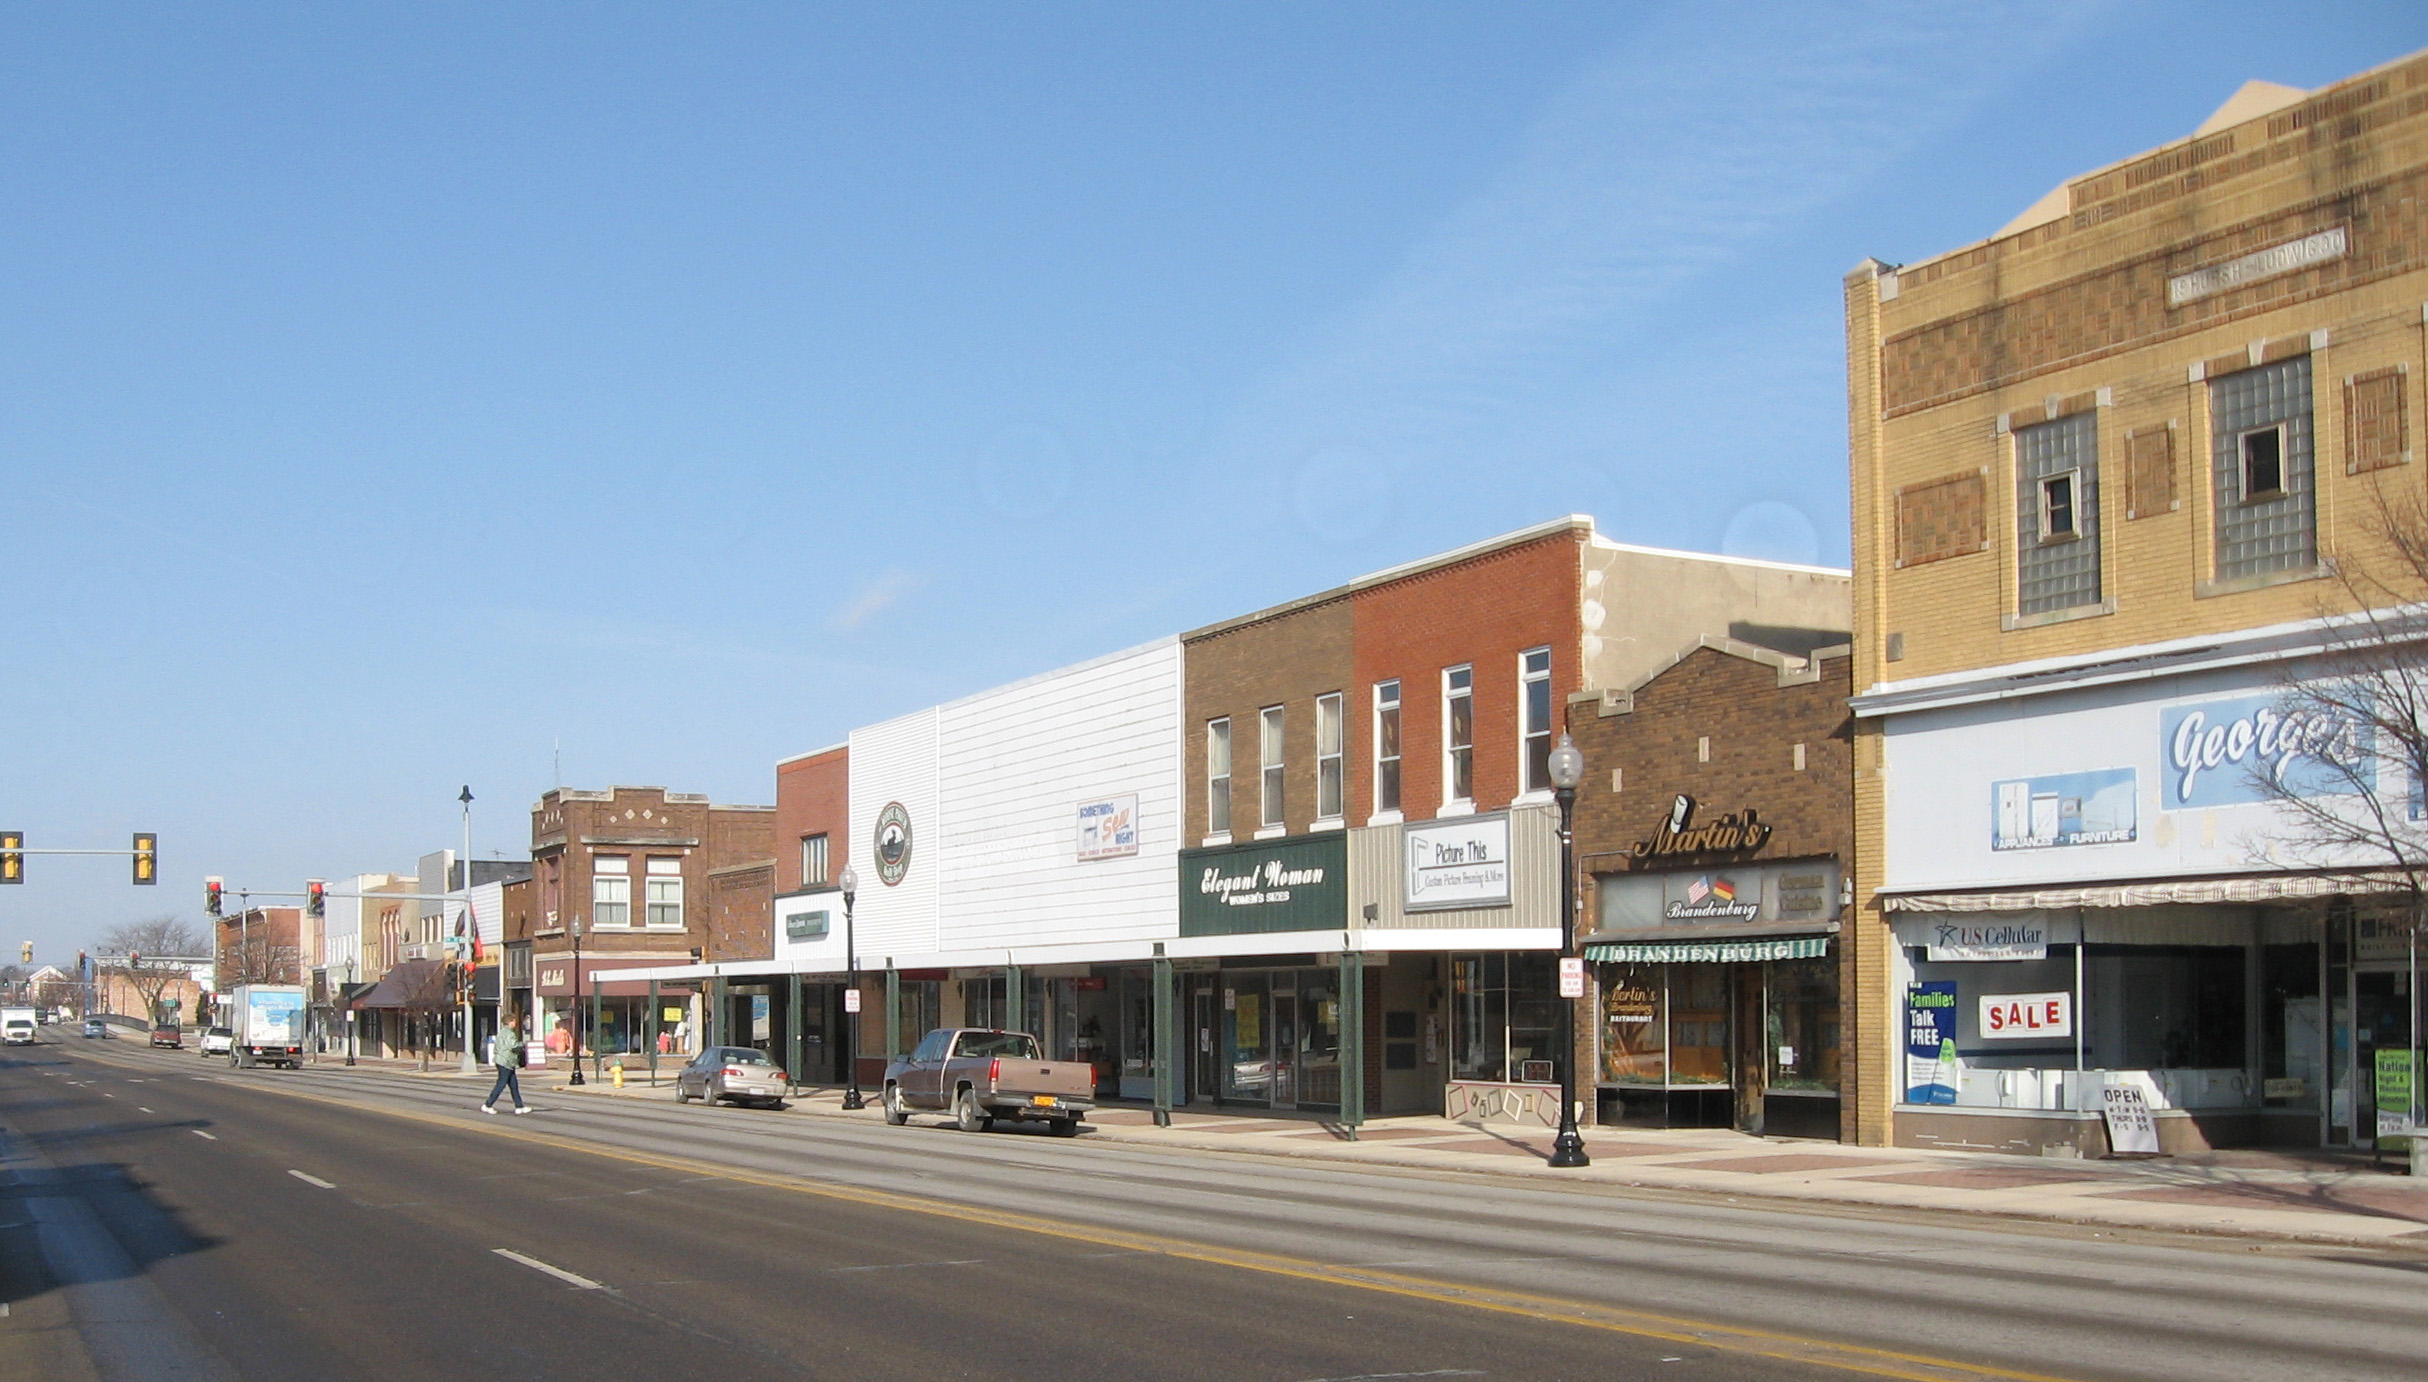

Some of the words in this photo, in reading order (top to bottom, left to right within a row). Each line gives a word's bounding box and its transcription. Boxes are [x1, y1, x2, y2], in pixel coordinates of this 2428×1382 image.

[2254, 238, 2317, 273] LUDWIG
[1633, 806, 1768, 857] Martin's
[1998, 835, 2054, 849] APPLIANCES
[2069, 829, 2129, 844] FURNITURE
[1436, 843, 1464, 864] Picture
[1467, 840, 1487, 861] This
[1201, 865, 1261, 903] Elegant
[1265, 860, 1324, 887] Woman
[1444, 874, 1461, 885] Picture
[1266, 890, 1290, 902] SIZES
[1667, 900, 1759, 922] Brandenburg
[1985, 925, 2042, 945] Cellular
[1614, 945, 1789, 963] BRANDENBURG
[1910, 991, 1955, 1008] Families
[1910, 1010, 1935, 1026] Talk
[1990, 1001, 2060, 1030] SALE
[1911, 1028, 1940, 1045] FREE
[2104, 1089, 2142, 1103] OPEN
